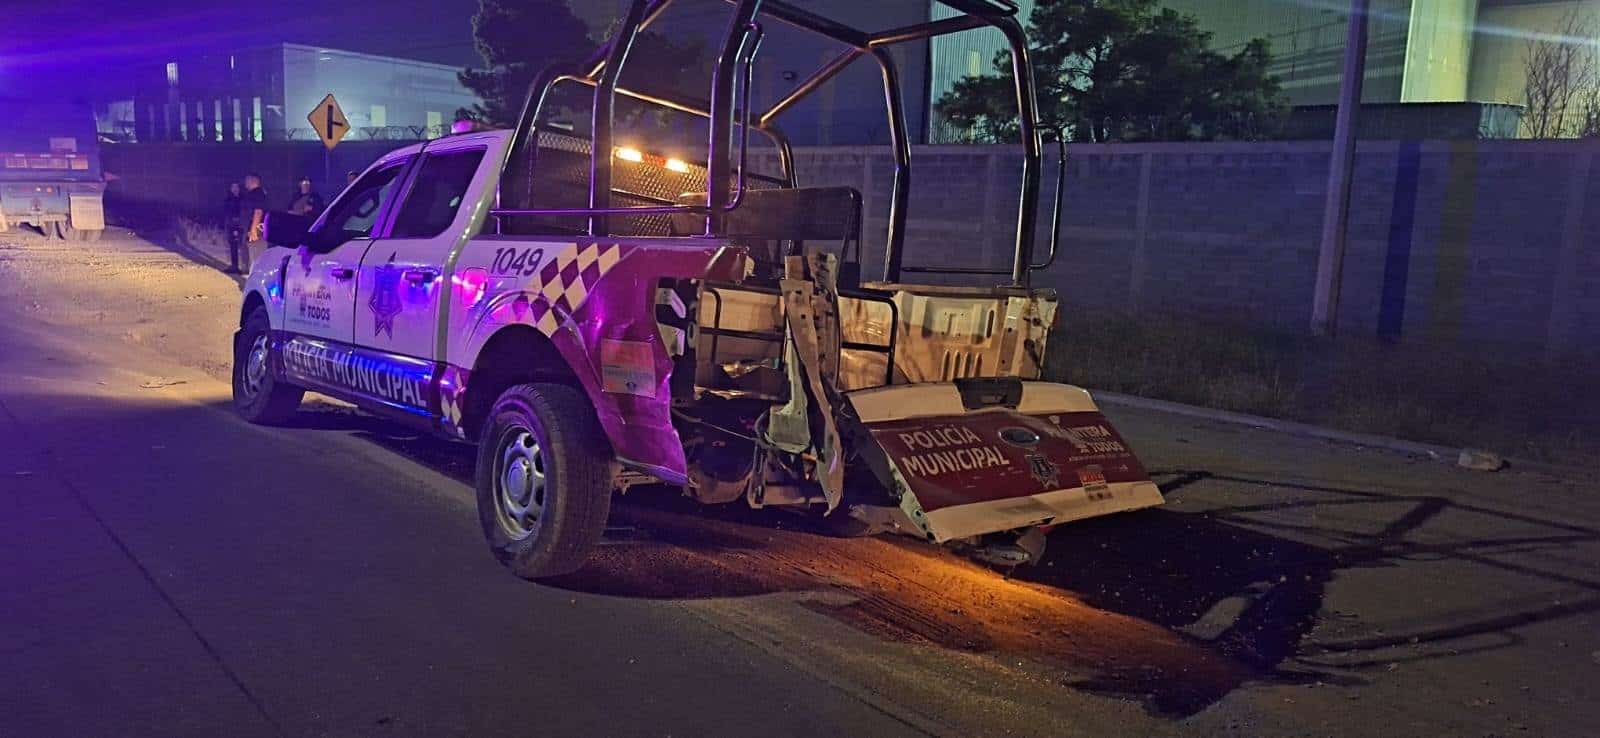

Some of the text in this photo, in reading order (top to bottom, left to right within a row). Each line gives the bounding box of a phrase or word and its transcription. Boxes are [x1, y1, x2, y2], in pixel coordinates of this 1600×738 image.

[490, 247, 544, 276] 1049
[307, 305, 330, 320] TODOS
[332, 350, 427, 406] MUNICIPAL
[901, 445, 1010, 477] MUNICIPAL
